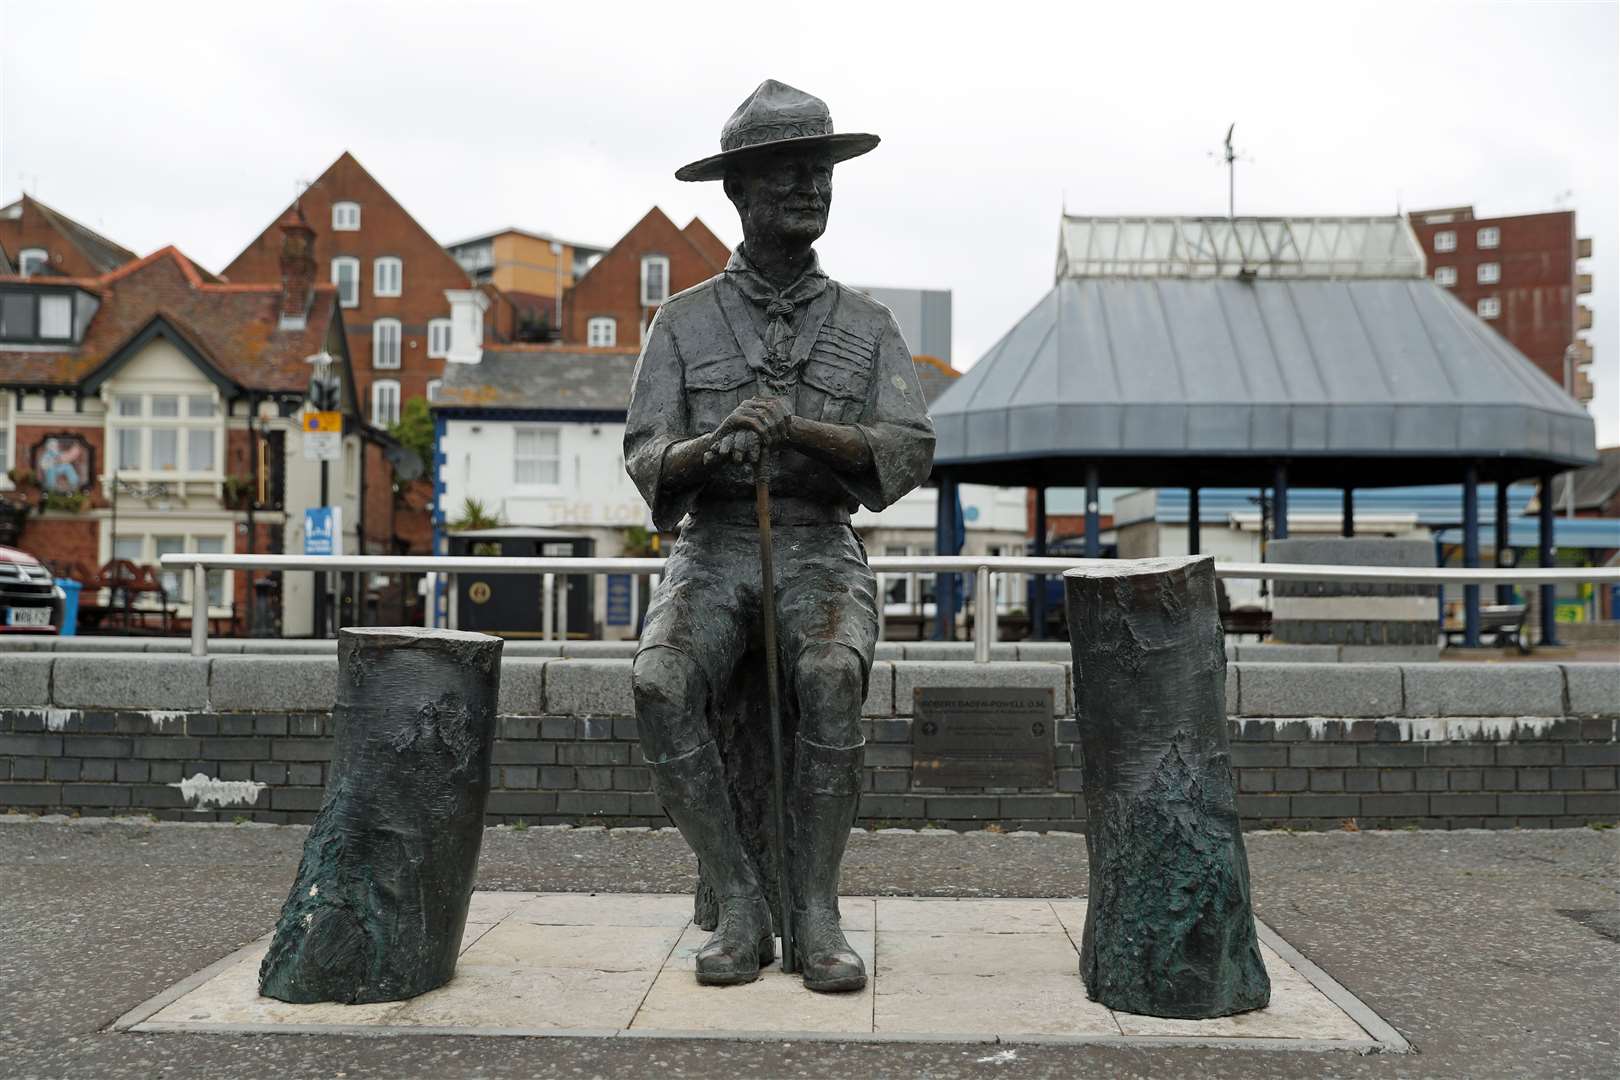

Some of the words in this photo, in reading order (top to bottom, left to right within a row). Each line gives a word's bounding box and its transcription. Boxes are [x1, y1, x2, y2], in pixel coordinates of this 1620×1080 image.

[548, 502, 593, 521] THE
[922, 699, 956, 709] ROBERT
[958, 699, 1024, 709] BADEN-POWELL
